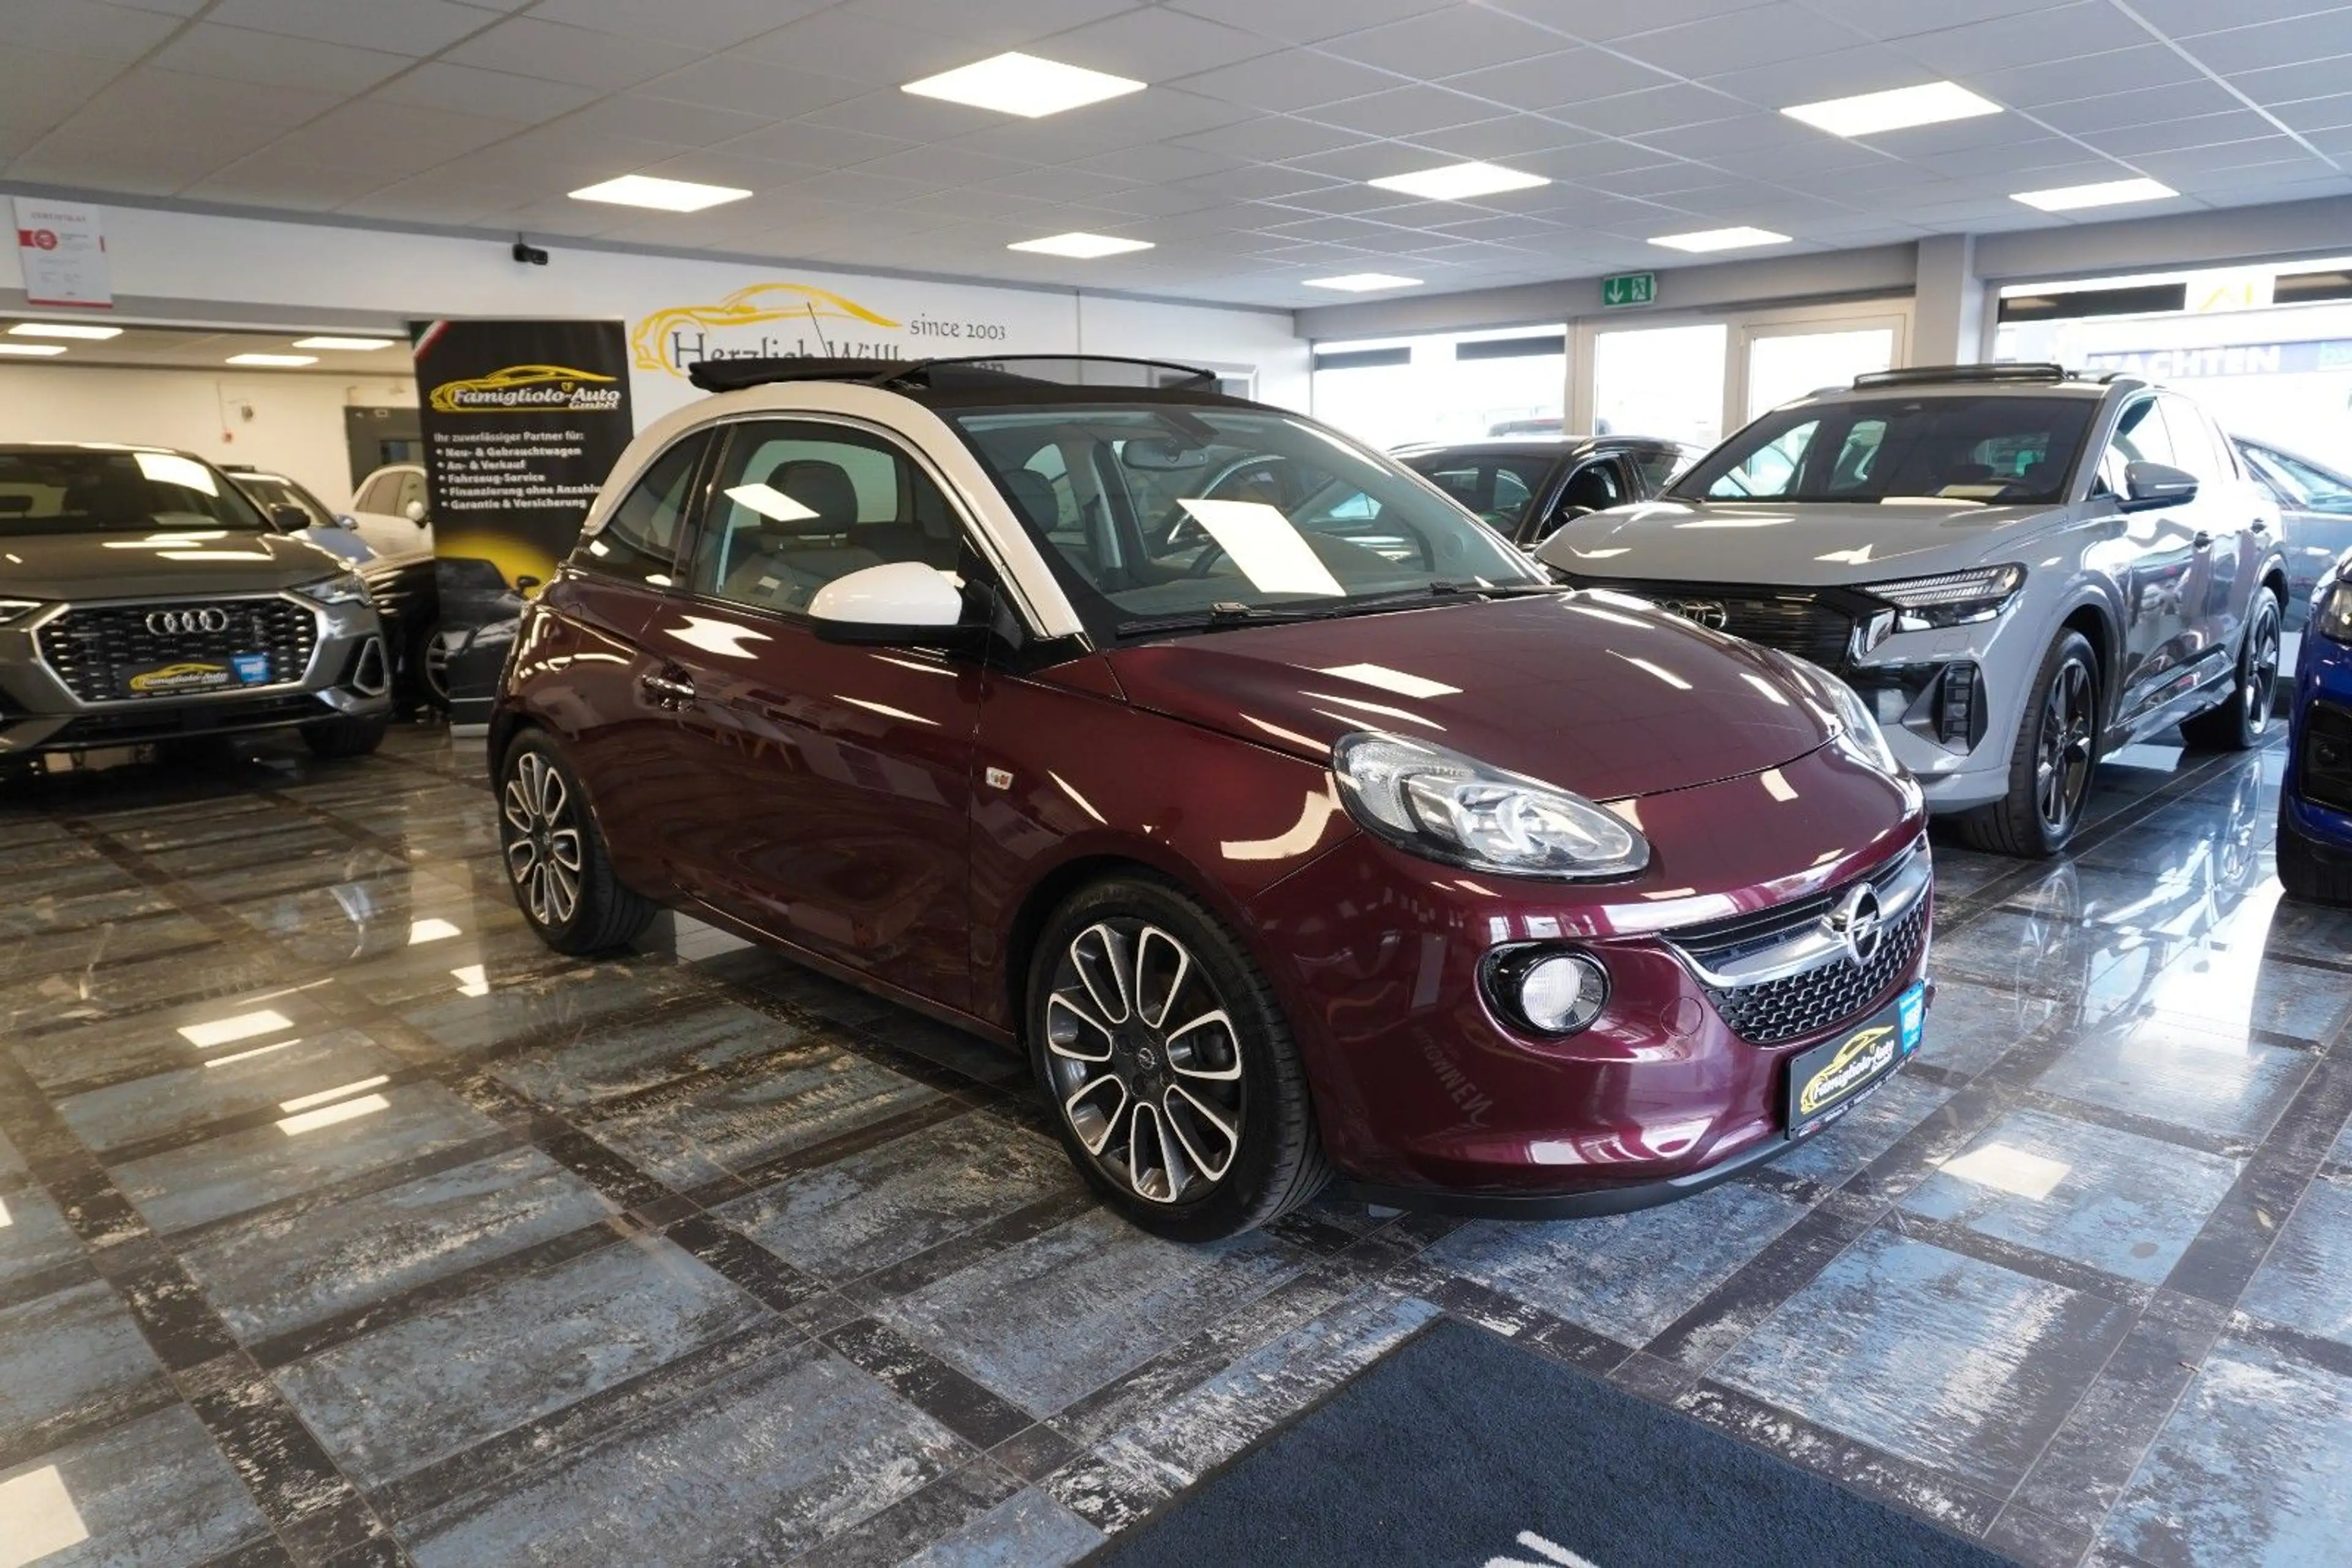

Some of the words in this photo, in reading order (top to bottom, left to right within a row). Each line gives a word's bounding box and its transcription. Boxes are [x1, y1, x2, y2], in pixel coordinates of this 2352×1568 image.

[910, 313, 959, 337] since
[966, 323, 1006, 341] 2003
[434, 432, 449, 443] Ihr
[452, 431, 521, 443] zuverlässiger
[524, 431, 563, 442] Partner
[565, 430, 584, 440] für:
[445, 448, 472, 458] Neu-
[475, 447, 484, 457] &
[486, 447, 582, 458] Gebrauchtwagen
[447, 461, 467, 470] An-
[470, 461, 479, 470] &
[480, 459, 527, 469] Verkauf
[448, 472, 546, 484] Fahrzeug-Service
[450, 486, 525, 497] Finanzierung
[526, 485, 554, 494] ohne
[556, 483, 602, 494] Anzahlu
[451, 499, 501, 510] Garantie
[502, 498, 511, 508] &
[513, 497, 587, 509] Versicherung
